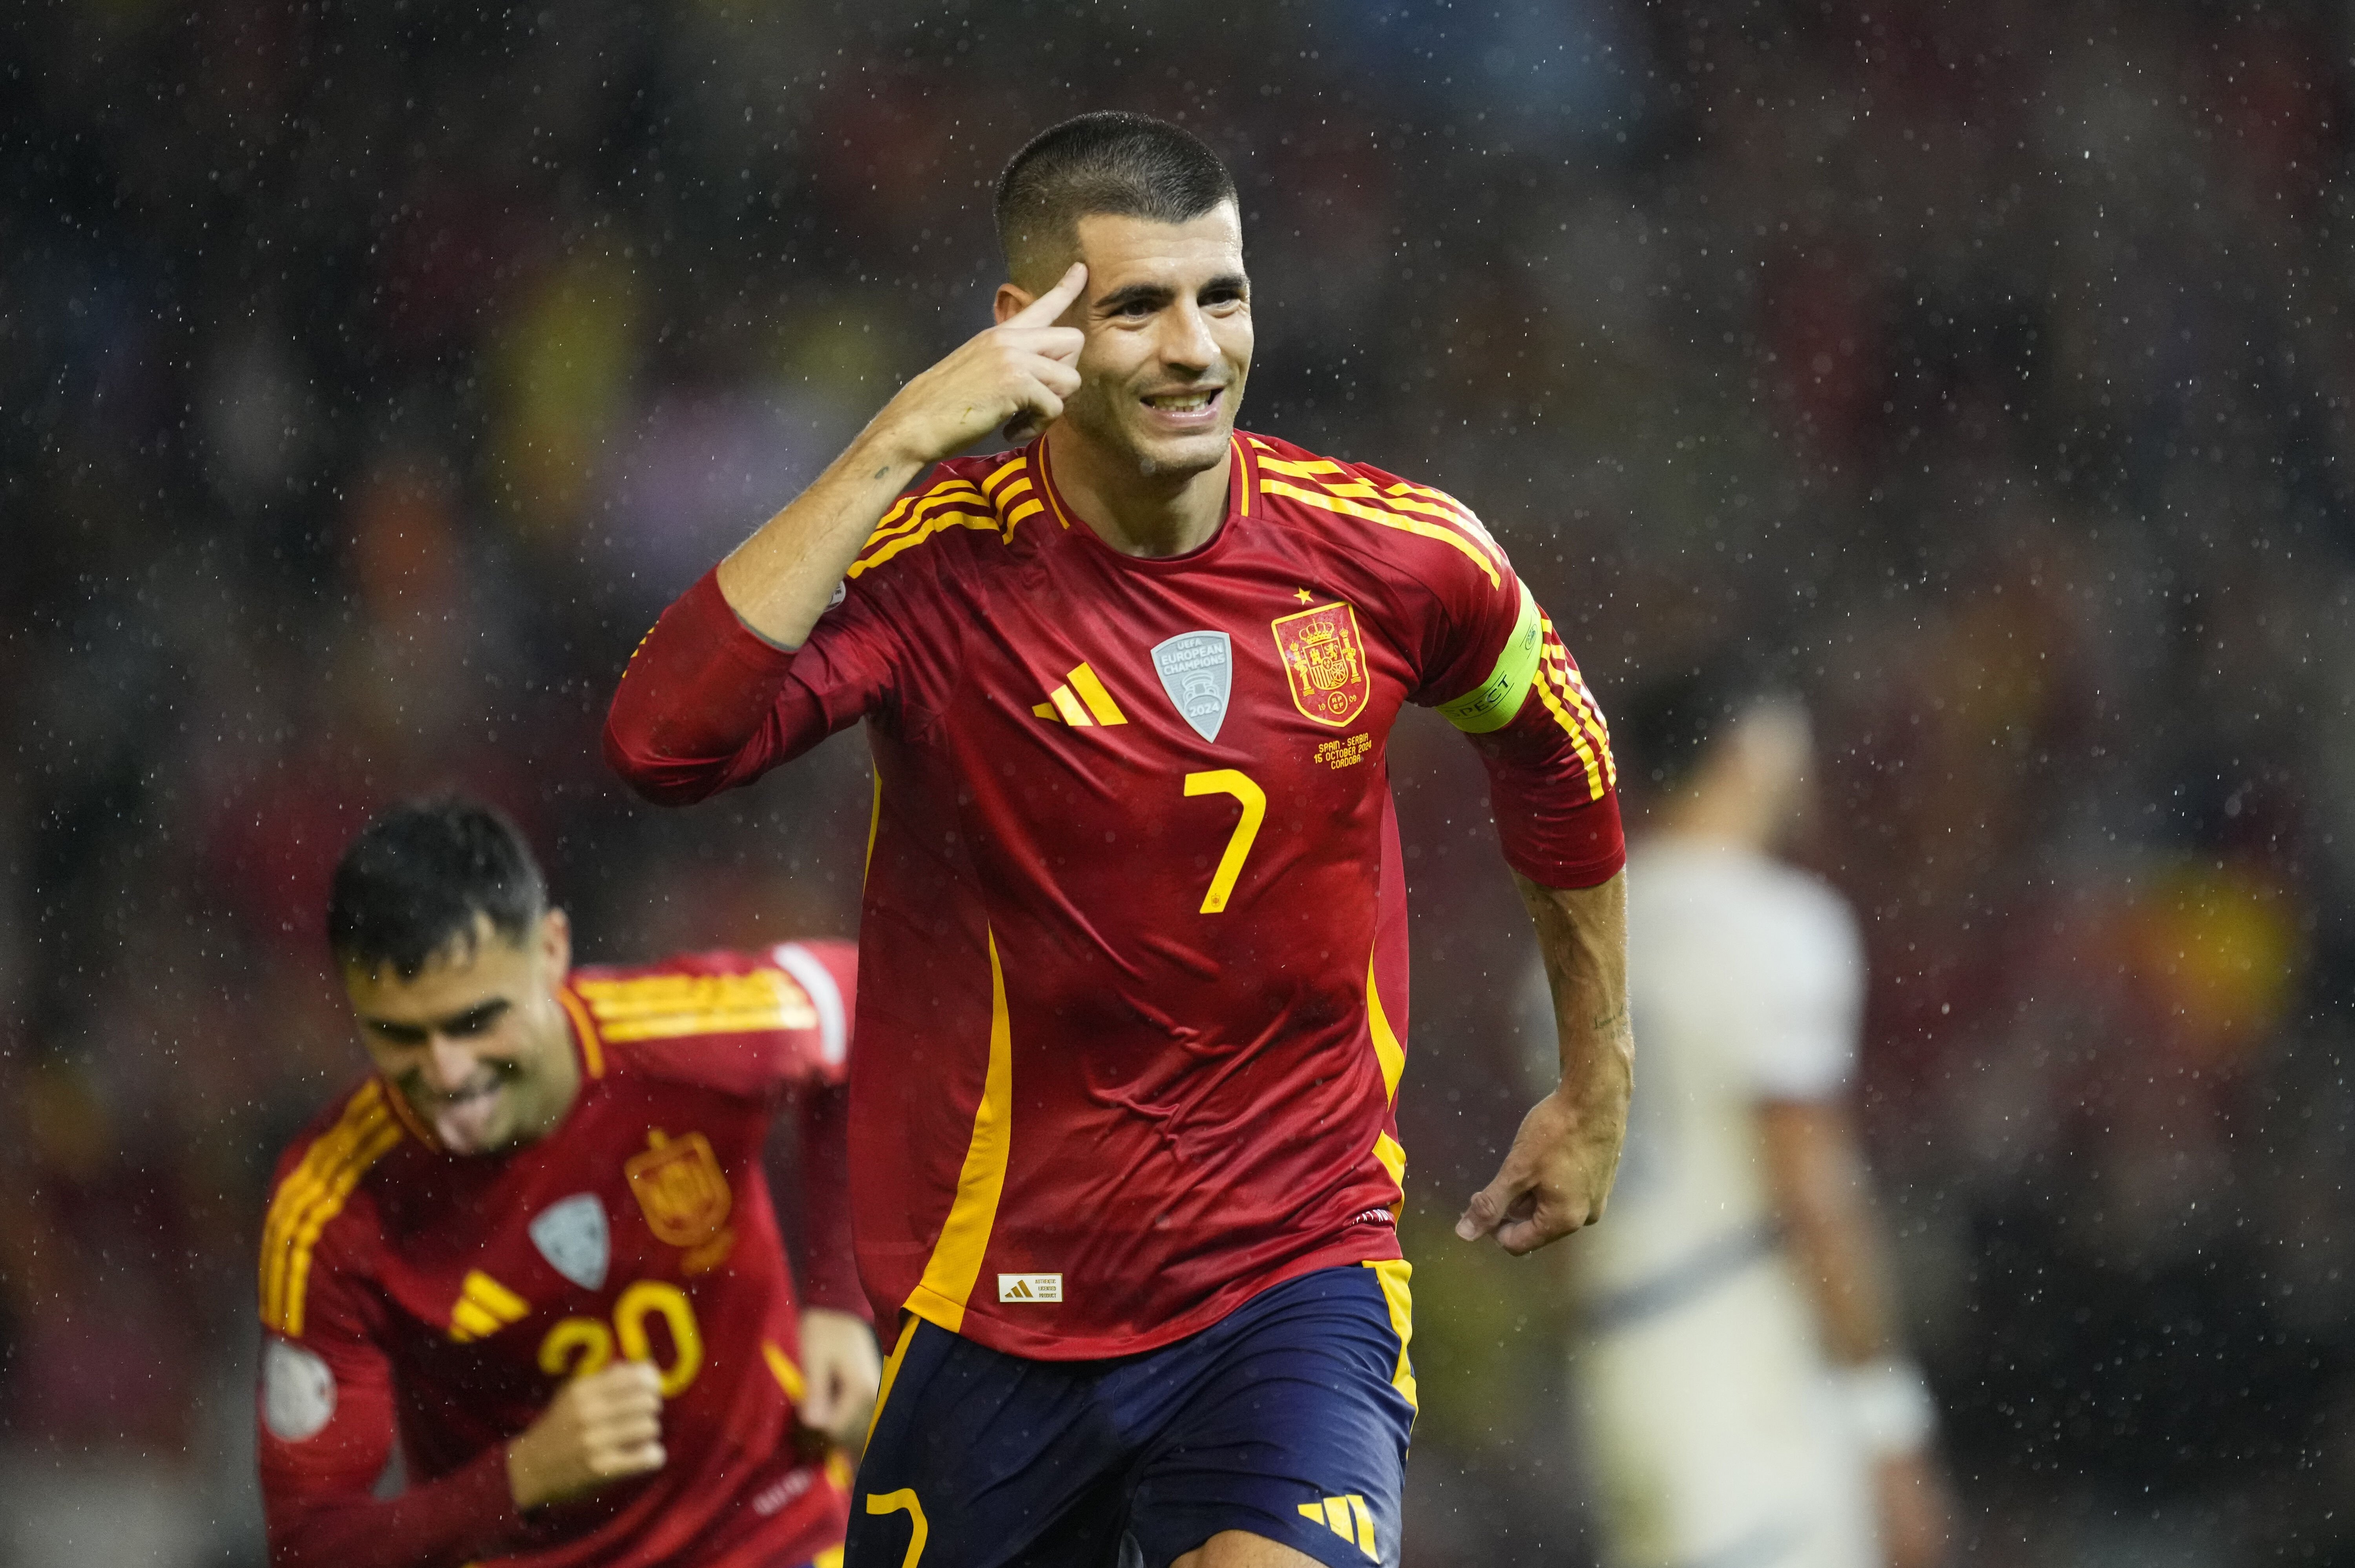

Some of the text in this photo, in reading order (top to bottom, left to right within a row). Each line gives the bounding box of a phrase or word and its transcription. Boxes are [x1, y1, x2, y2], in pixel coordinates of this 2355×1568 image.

[1161, 642, 1223, 665] EUROPEAN
[1177, 638, 1202, 650] UEFA
[1163, 654, 1225, 675] CHAMPIONS
[1189, 702, 1219, 717] 2024
[1314, 740, 1372, 764] 15 OCTOBER 2024
[1318, 740, 1340, 753] SPAIN
[1347, 732, 1368, 746] SERBIA
[1331, 754, 1360, 769] CORDOBA
[1183, 769, 1266, 914] 7
[866, 1488, 928, 1568] 7
